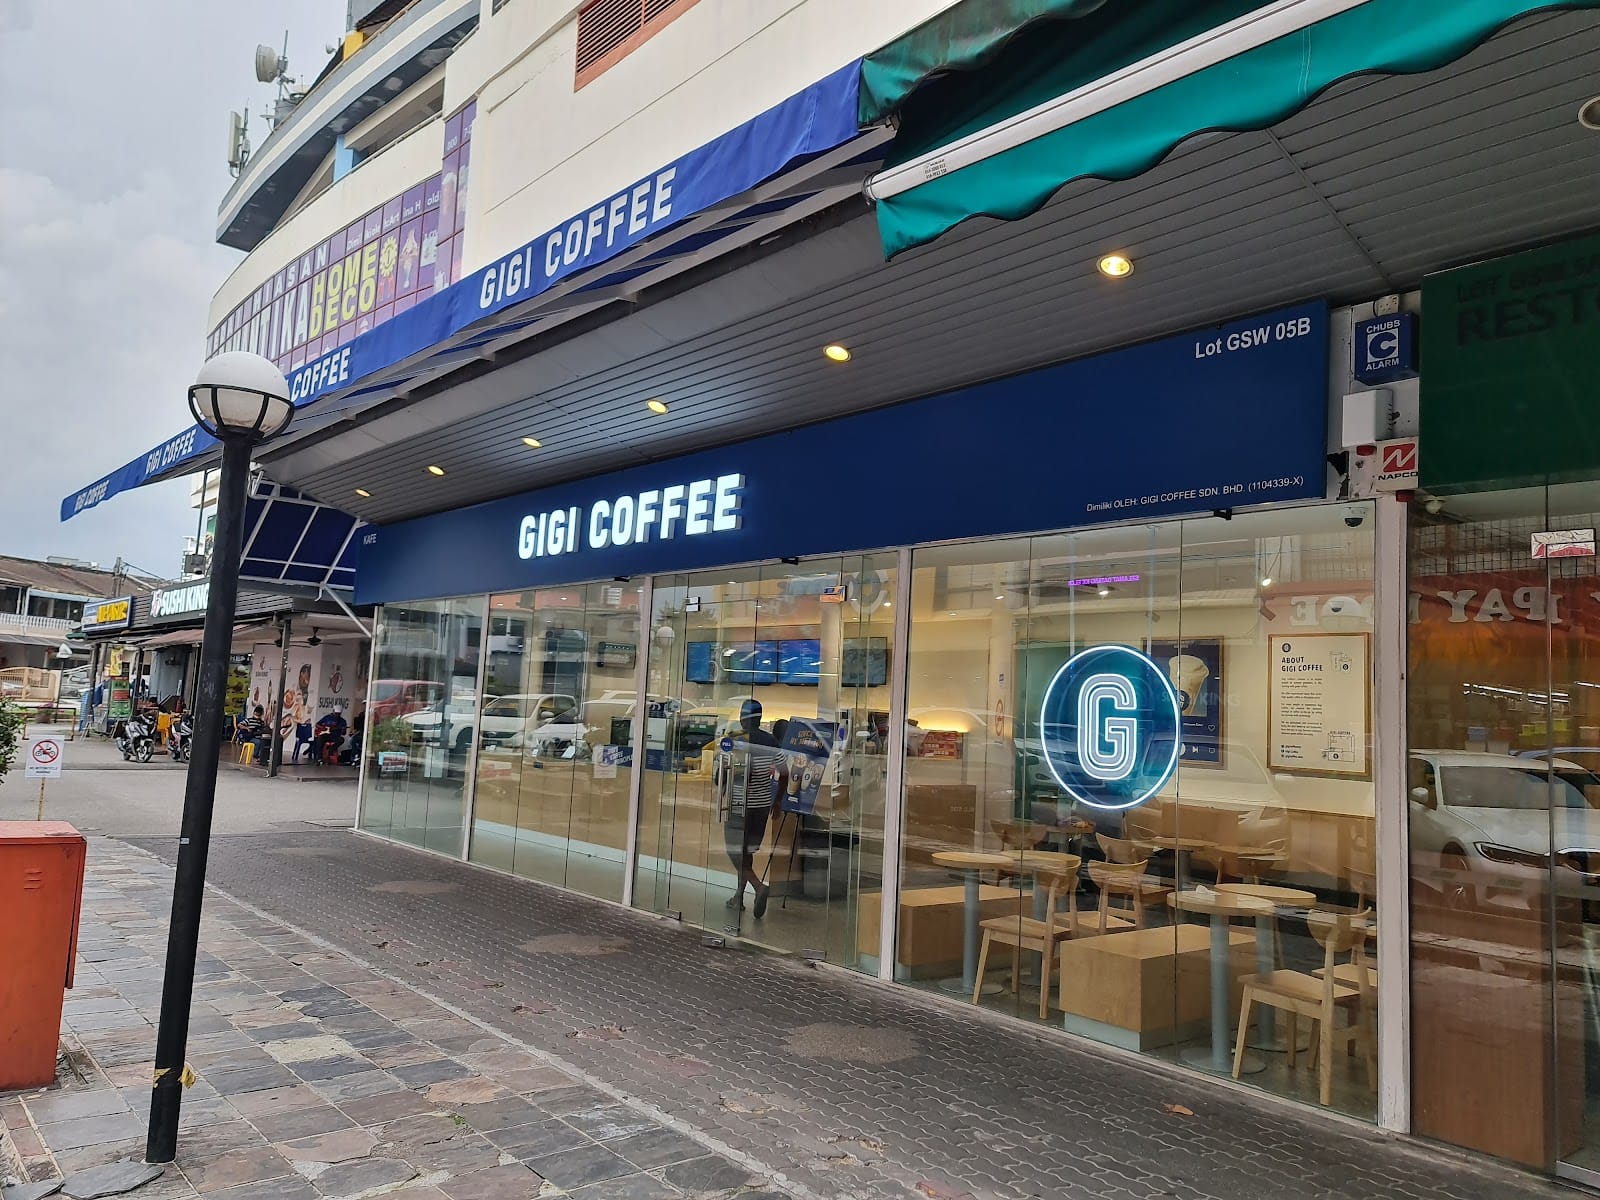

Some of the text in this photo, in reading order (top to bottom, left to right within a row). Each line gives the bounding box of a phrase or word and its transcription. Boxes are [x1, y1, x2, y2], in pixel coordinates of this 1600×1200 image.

[480, 167, 677, 309] GIGI COFFEE
[313, 242, 378, 306] HOME
[308, 277, 377, 339] DECO
[1366, 319, 1401, 334] CHUBB
[1195, 317, 1311, 359] Lot GSW 05B
[291, 347, 351, 402] COFFEE
[1365, 357, 1400, 371] ALARM
[162, 428, 197, 467] COFFEE
[1086, 475, 1304, 512] Dimiliki OLEH: GIGI COFFEE SDN. BHD. (1104339-X)
[1377, 471, 1419, 481] NAPCO
[518, 473, 745, 560] GIGI COFFEE
[363, 533, 377, 545] KAFE
[160, 588, 186, 616] SUSHI
[1298, 664, 1324, 672] COFFEE
[1078, 673, 1137, 781] G
